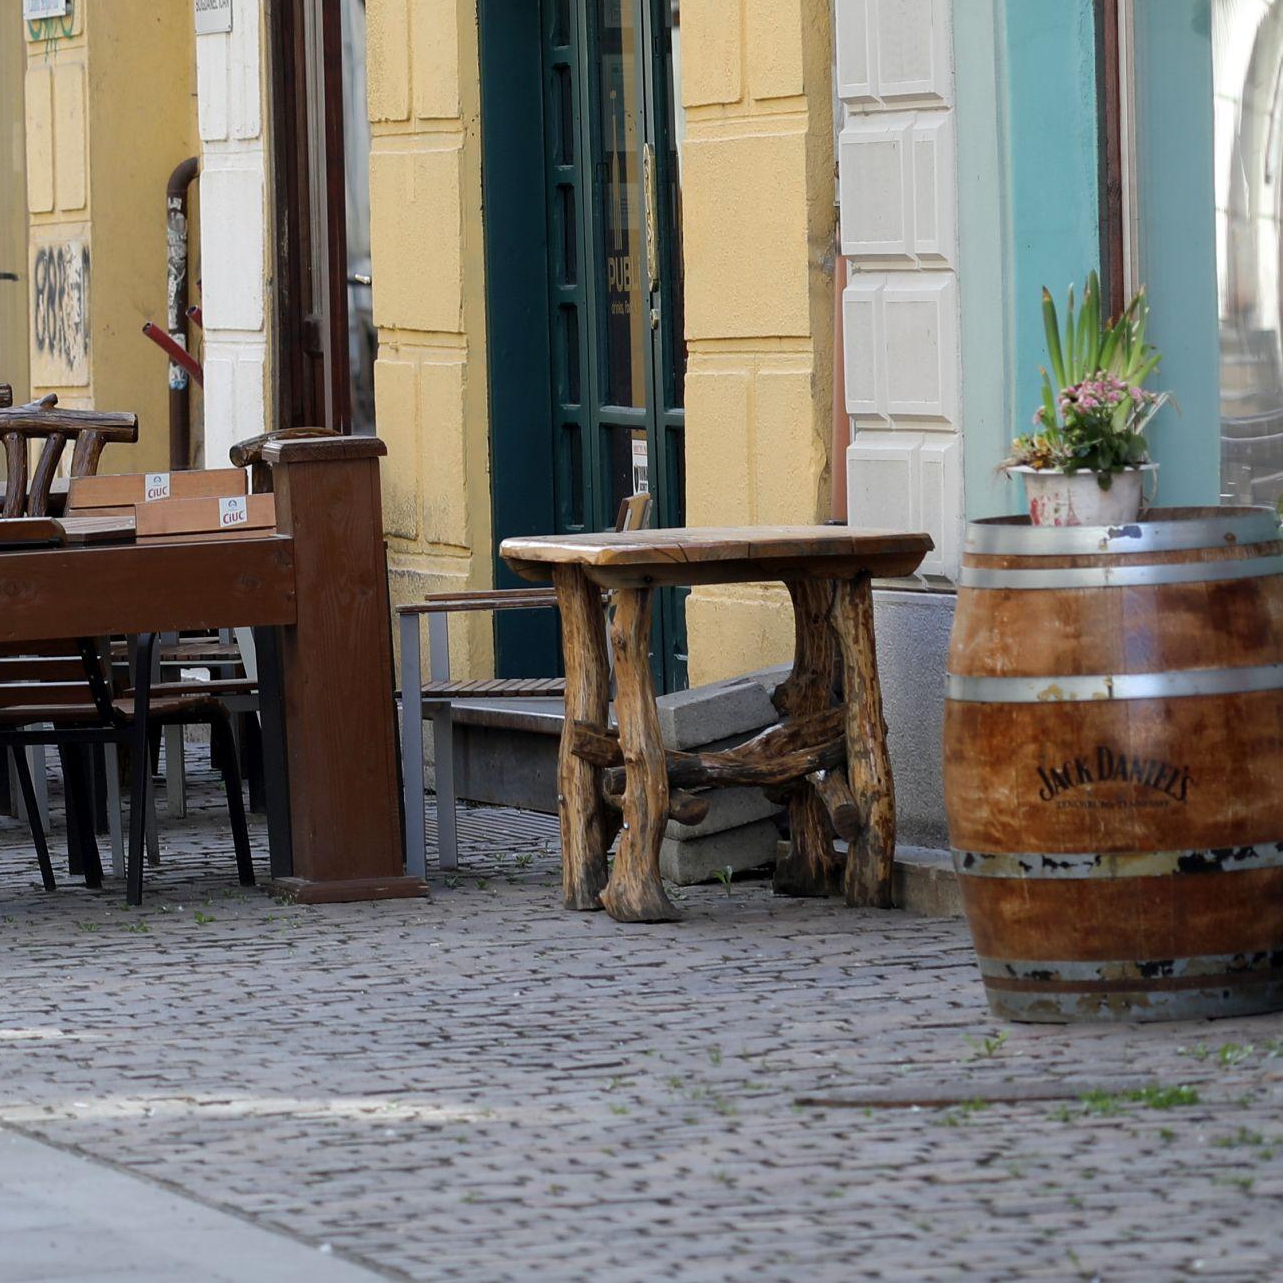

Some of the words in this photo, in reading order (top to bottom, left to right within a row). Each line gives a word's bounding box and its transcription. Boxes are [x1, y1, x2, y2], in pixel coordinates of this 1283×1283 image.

[147, 486, 168, 499] CIUC
[223, 511, 245, 524] CIUC
[1037, 756, 1094, 803] JACK
[1096, 745, 1198, 804] DANIEL'S
